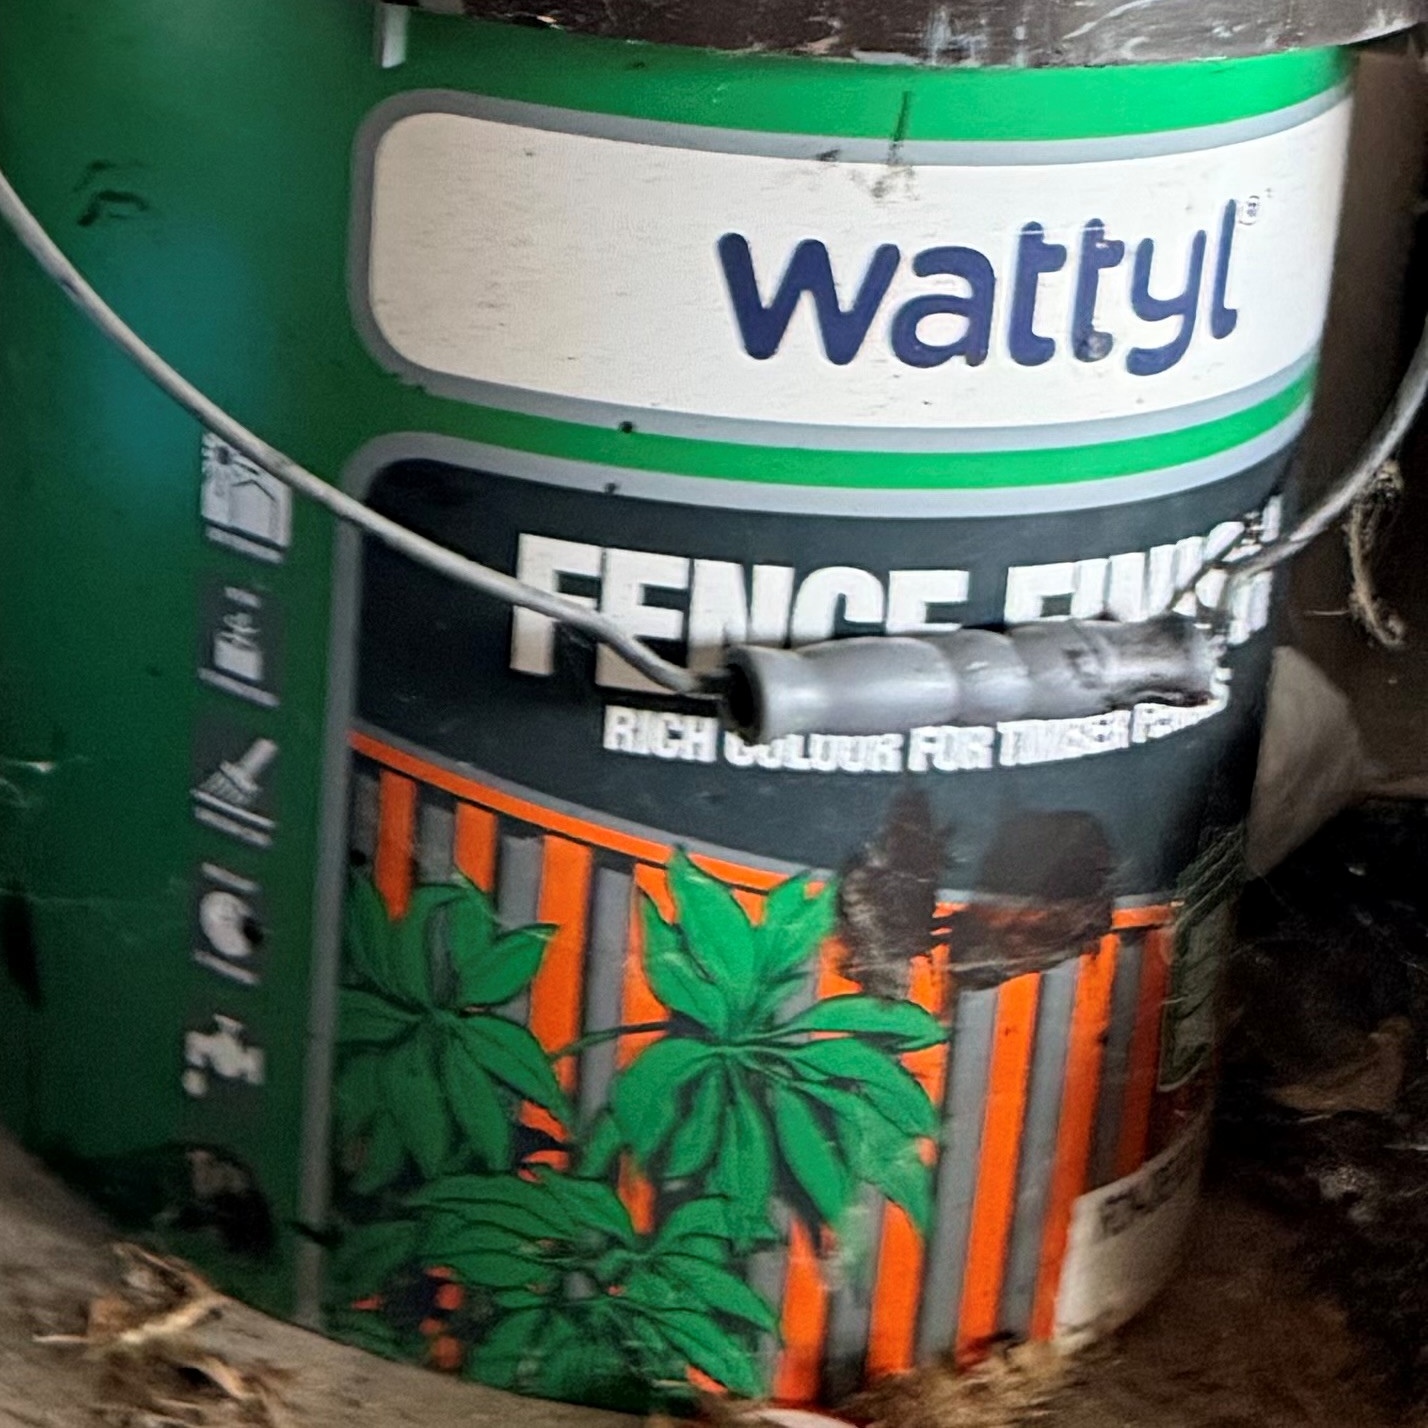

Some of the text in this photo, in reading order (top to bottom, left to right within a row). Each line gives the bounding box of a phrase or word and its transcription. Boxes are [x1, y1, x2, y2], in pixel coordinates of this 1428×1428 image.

[716, 196, 1238, 378] wattyl
[603, 704, 719, 765] RICH
[908, 724, 993, 774] FOR
[996, 709, 1132, 770] TIMBER
